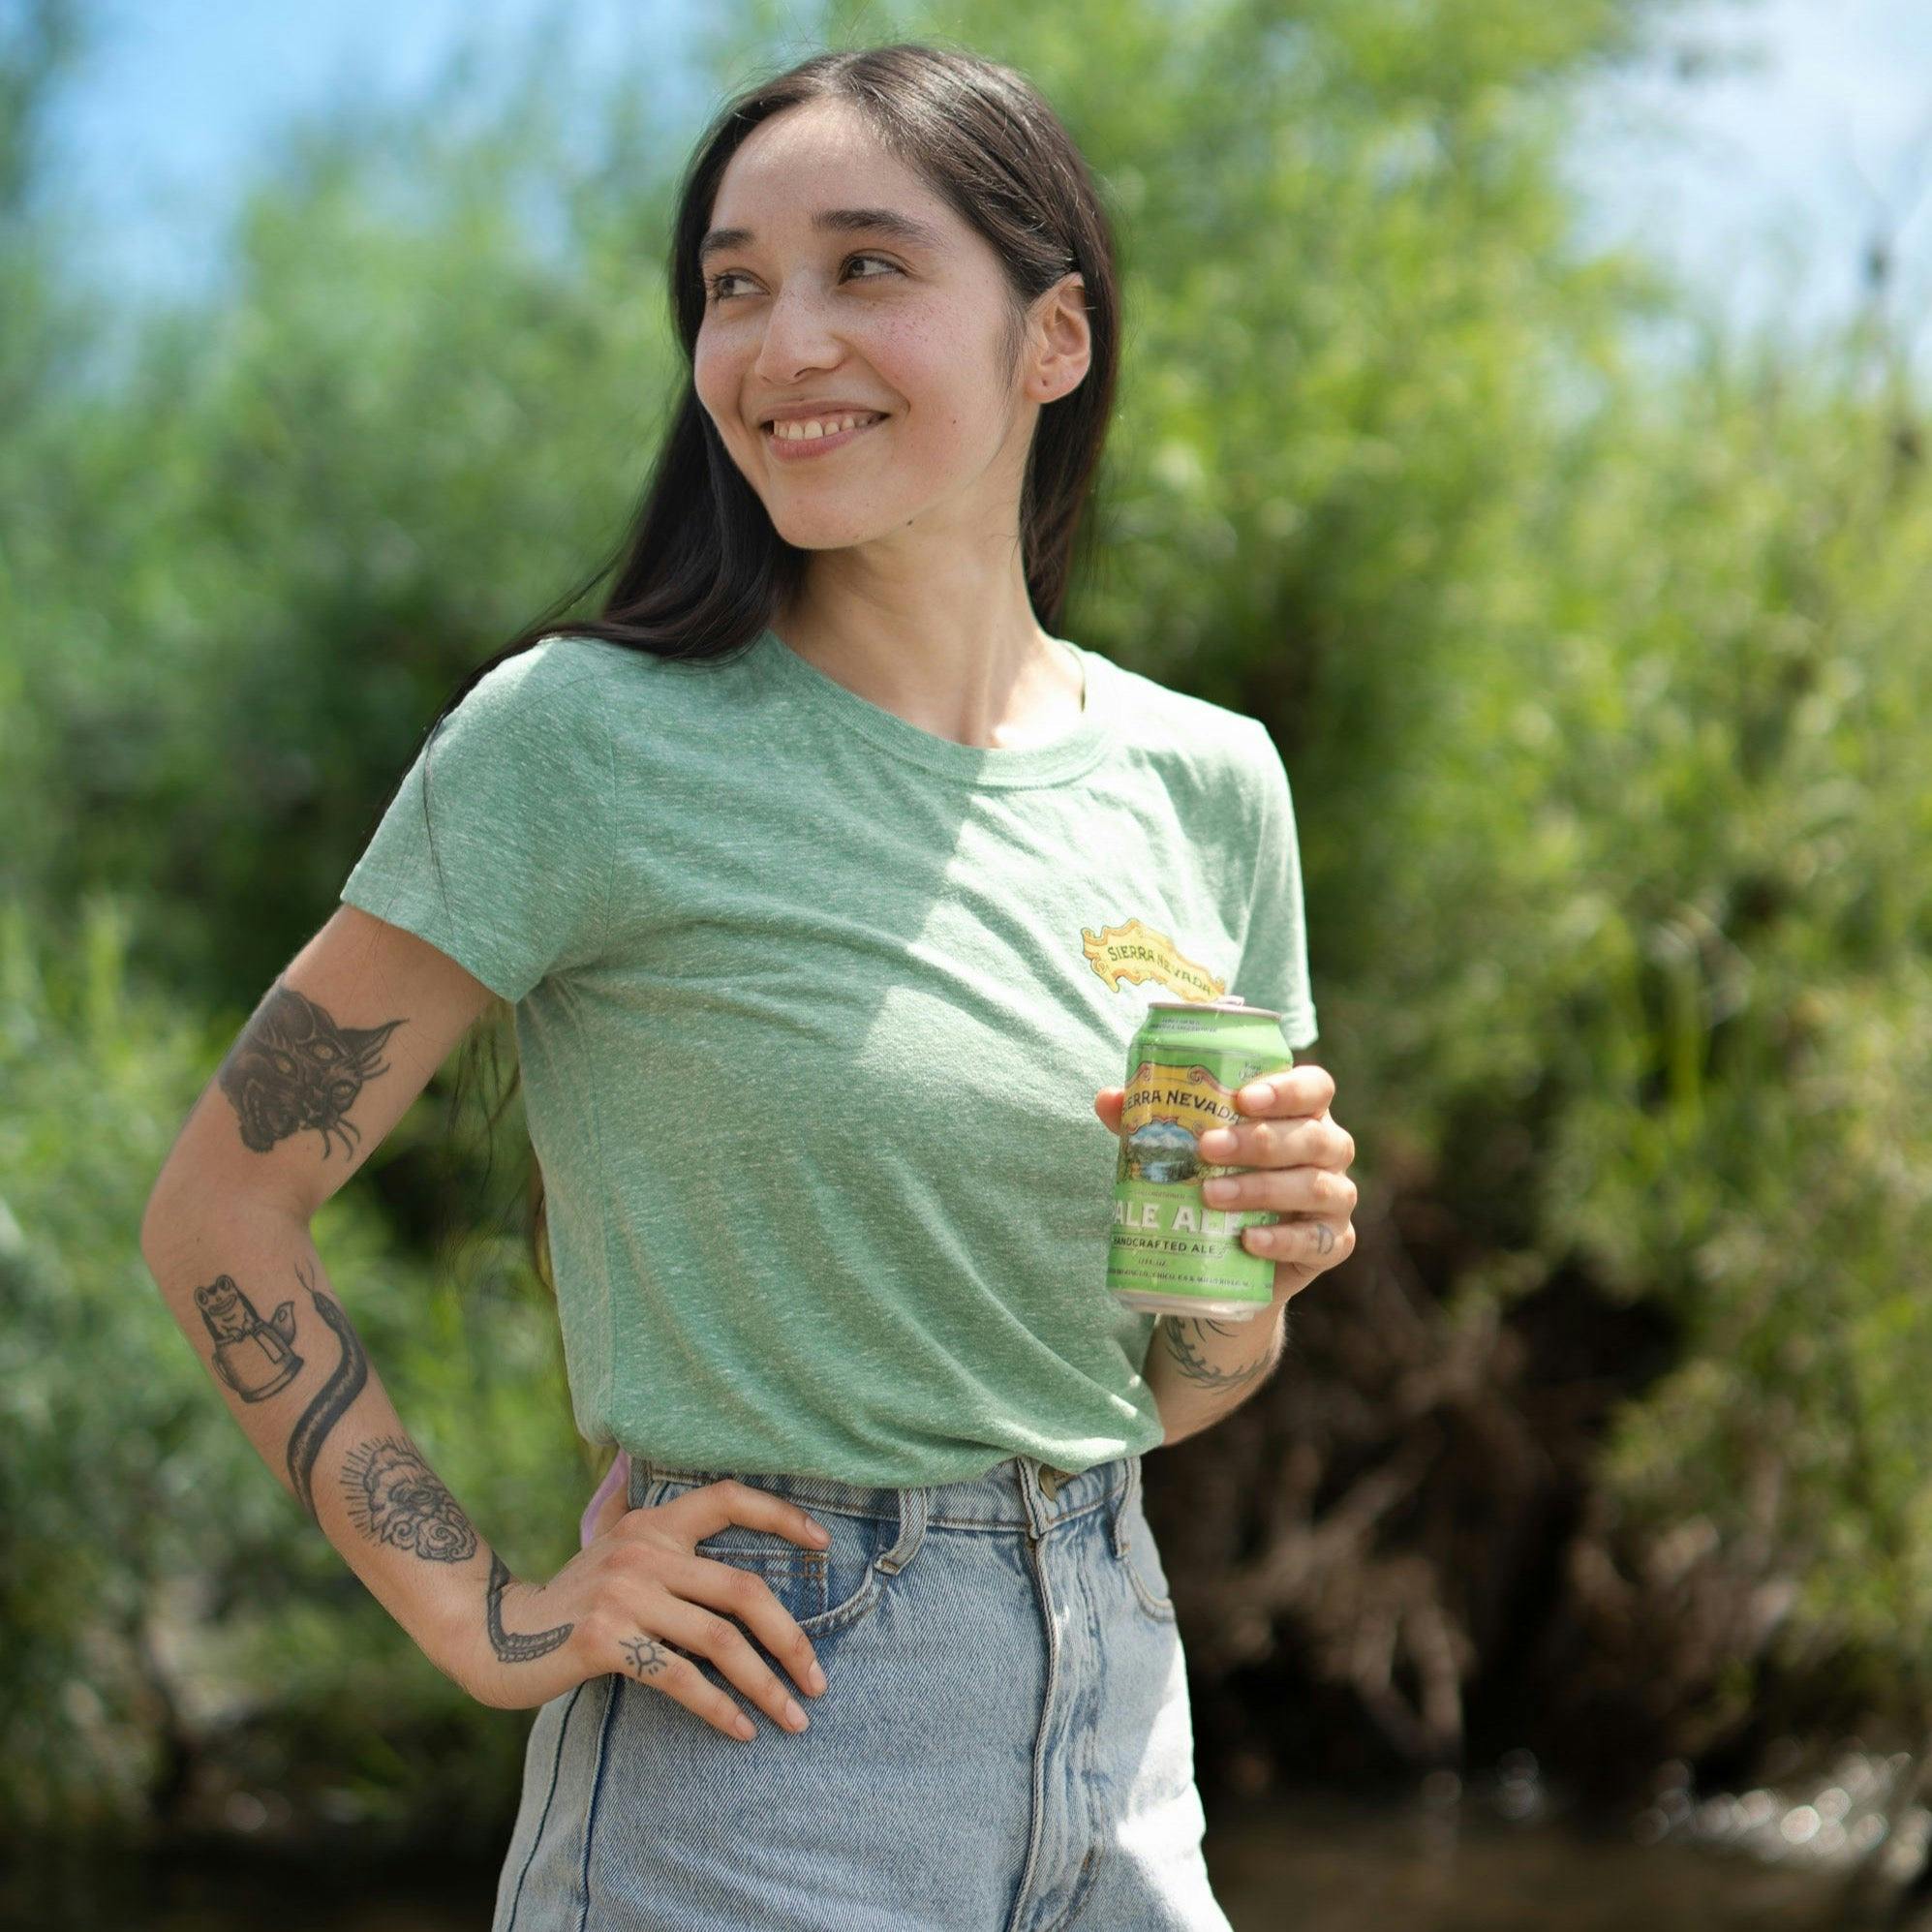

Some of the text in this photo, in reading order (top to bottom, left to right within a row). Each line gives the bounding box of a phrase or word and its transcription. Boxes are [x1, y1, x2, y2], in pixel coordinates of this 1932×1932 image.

[1108, 945, 1155, 962] SIERRA
[1166, 1089, 1242, 1125] NEVADA
[1190, 1243, 1216, 1254] ALE
